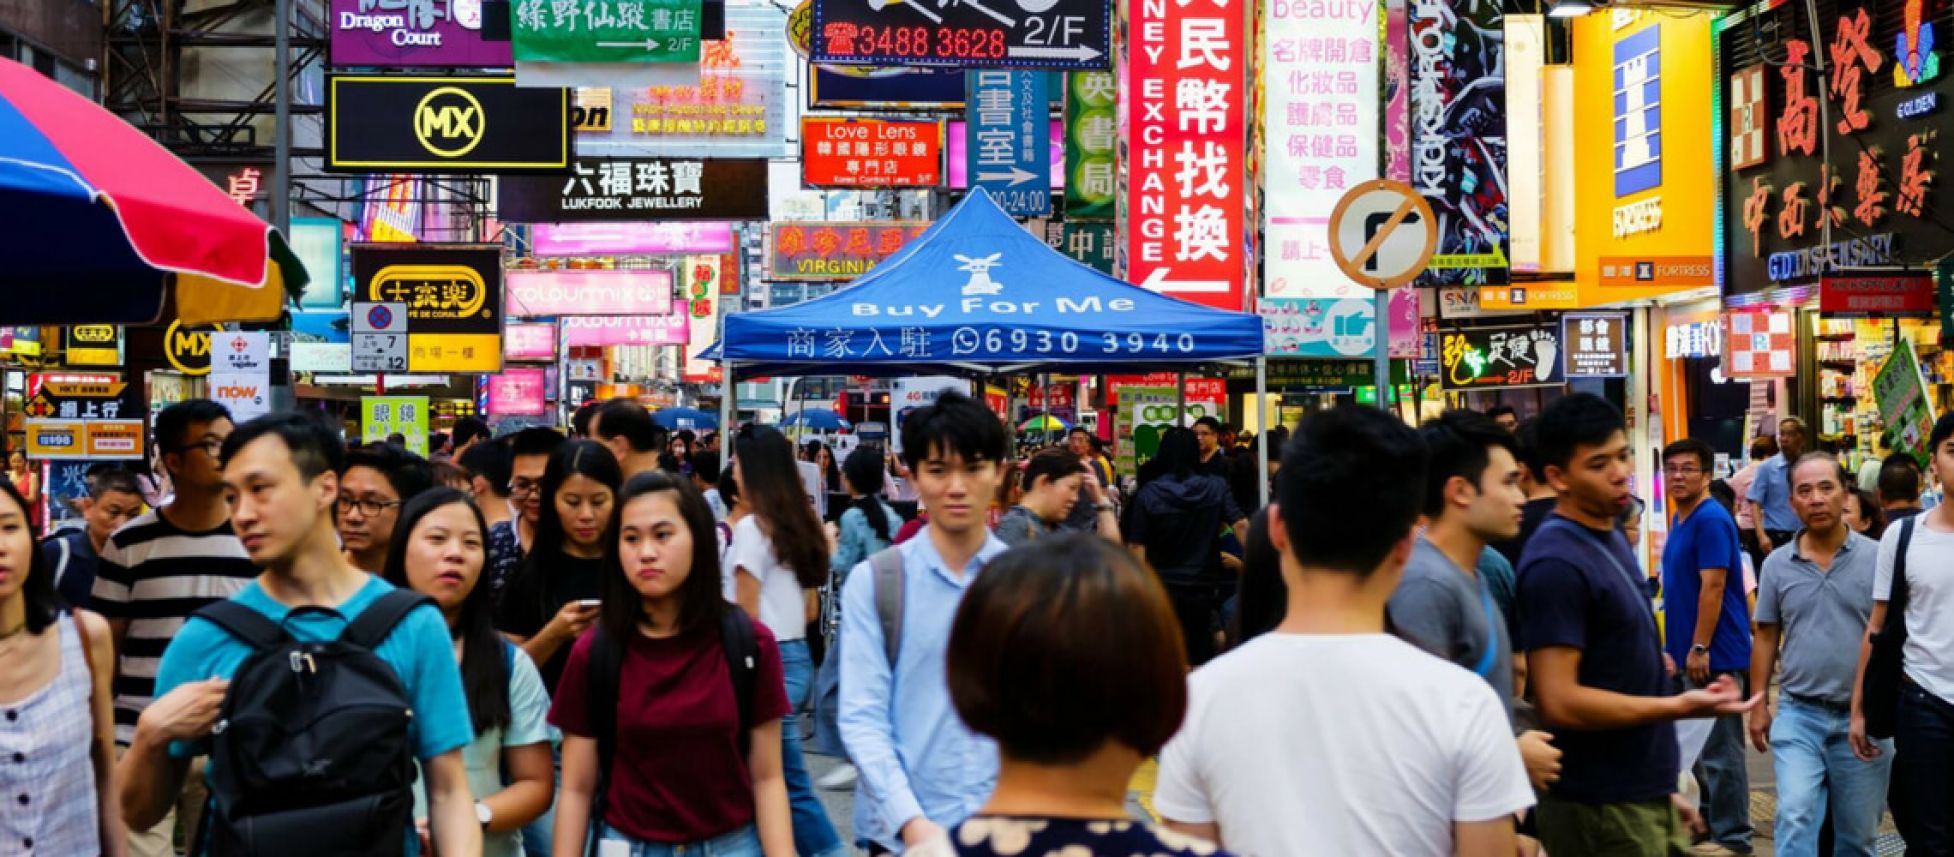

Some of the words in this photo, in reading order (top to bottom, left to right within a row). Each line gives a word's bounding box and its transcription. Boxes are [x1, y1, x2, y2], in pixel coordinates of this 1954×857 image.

[340, 11, 404, 32] Dragon
[1272, 0, 1372, 24] beauty
[392, 29, 442, 46] Court
[859, 25, 929, 56] 3488
[937, 26, 1006, 58] 3628
[1024, 16, 1086, 46] 2/F
[667, 38, 693, 52] 2/F
[1272, 37, 1373, 64] 名牌開倉
[1288, 70, 1358, 96] 化妝品
[422, 106, 474, 138] MX
[1286, 102, 1358, 127] 護膚品
[826, 123, 869, 139] Love
[878, 123, 917, 139] Lens
[1286, 133, 1358, 158] 保健品
[846, 159, 898, 174] 專門店
[1142, 79, 1165, 262] EXCHANGE
[561, 161, 703, 196] 六福珠寶
[1299, 166, 1347, 190] 零食
[562, 197, 622, 209] LUKFOOK
[627, 197, 703, 209] JEWELLERY
[797, 259, 875, 273] VIRGINIA
[1657, 264, 1710, 277] FORTRESS
[852, 303, 944, 318] Buy
[961, 297, 1041, 313] For
[1056, 296, 1136, 313] Me
[387, 336, 396, 348] 7
[785, 326, 933, 358] 商家入駐
[986, 331, 1078, 353] 6930
[1103, 332, 1194, 353] 3940
[388, 357, 404, 369] 12
[1507, 370, 1533, 384] 2/F
[217, 386, 257, 398] now
[59, 400, 119, 418] 網上行
[374, 403, 415, 422] 眼鏡
